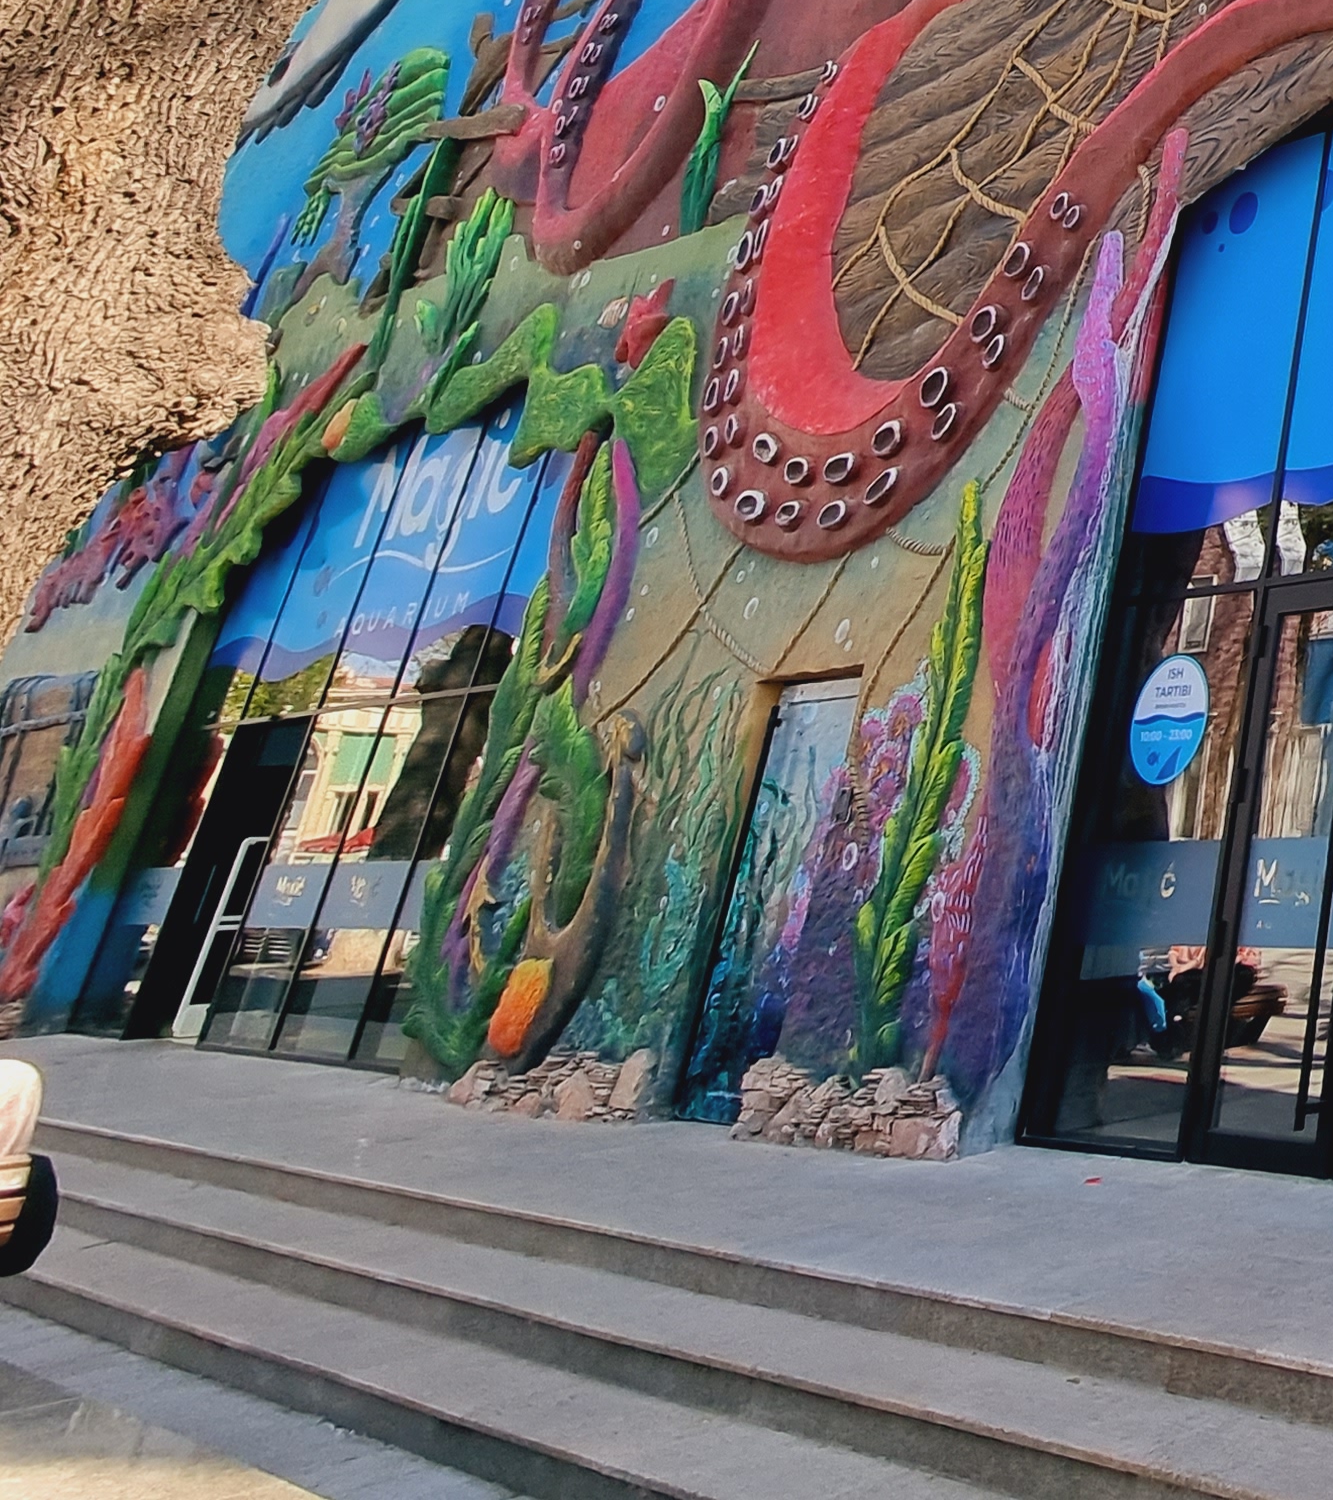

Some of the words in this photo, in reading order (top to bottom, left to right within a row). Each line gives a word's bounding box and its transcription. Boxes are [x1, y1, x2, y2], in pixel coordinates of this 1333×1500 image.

[334, 591, 470, 637] AQUARIUM
[1168, 668, 1184, 680] ISH
[1155, 684, 1192, 698] TARTIBI
